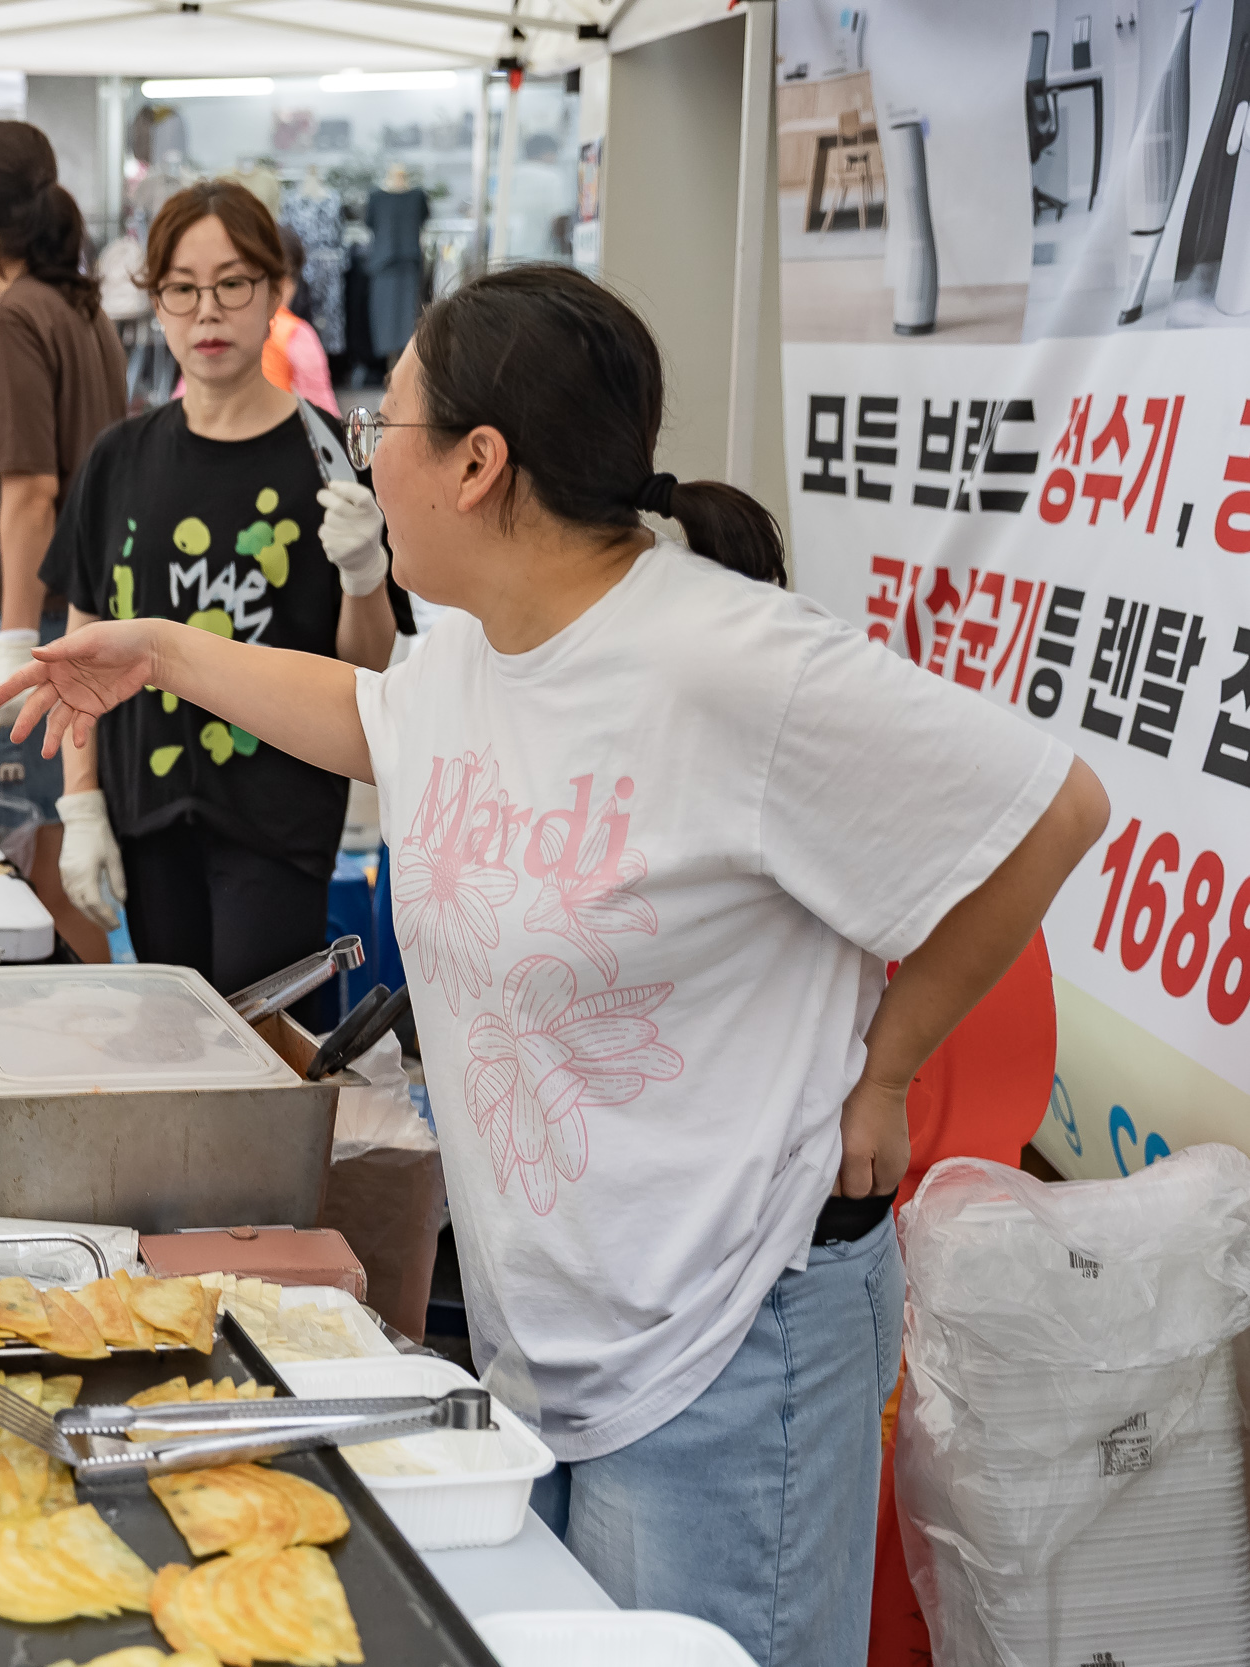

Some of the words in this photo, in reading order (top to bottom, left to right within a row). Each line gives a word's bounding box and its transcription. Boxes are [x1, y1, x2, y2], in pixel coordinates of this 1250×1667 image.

[802, 393, 899, 503] 모든
[1081, 595, 1207, 759] 렌탈
[402, 755, 635, 882] Mardi
[1093, 816, 1250, 1026] 1688
